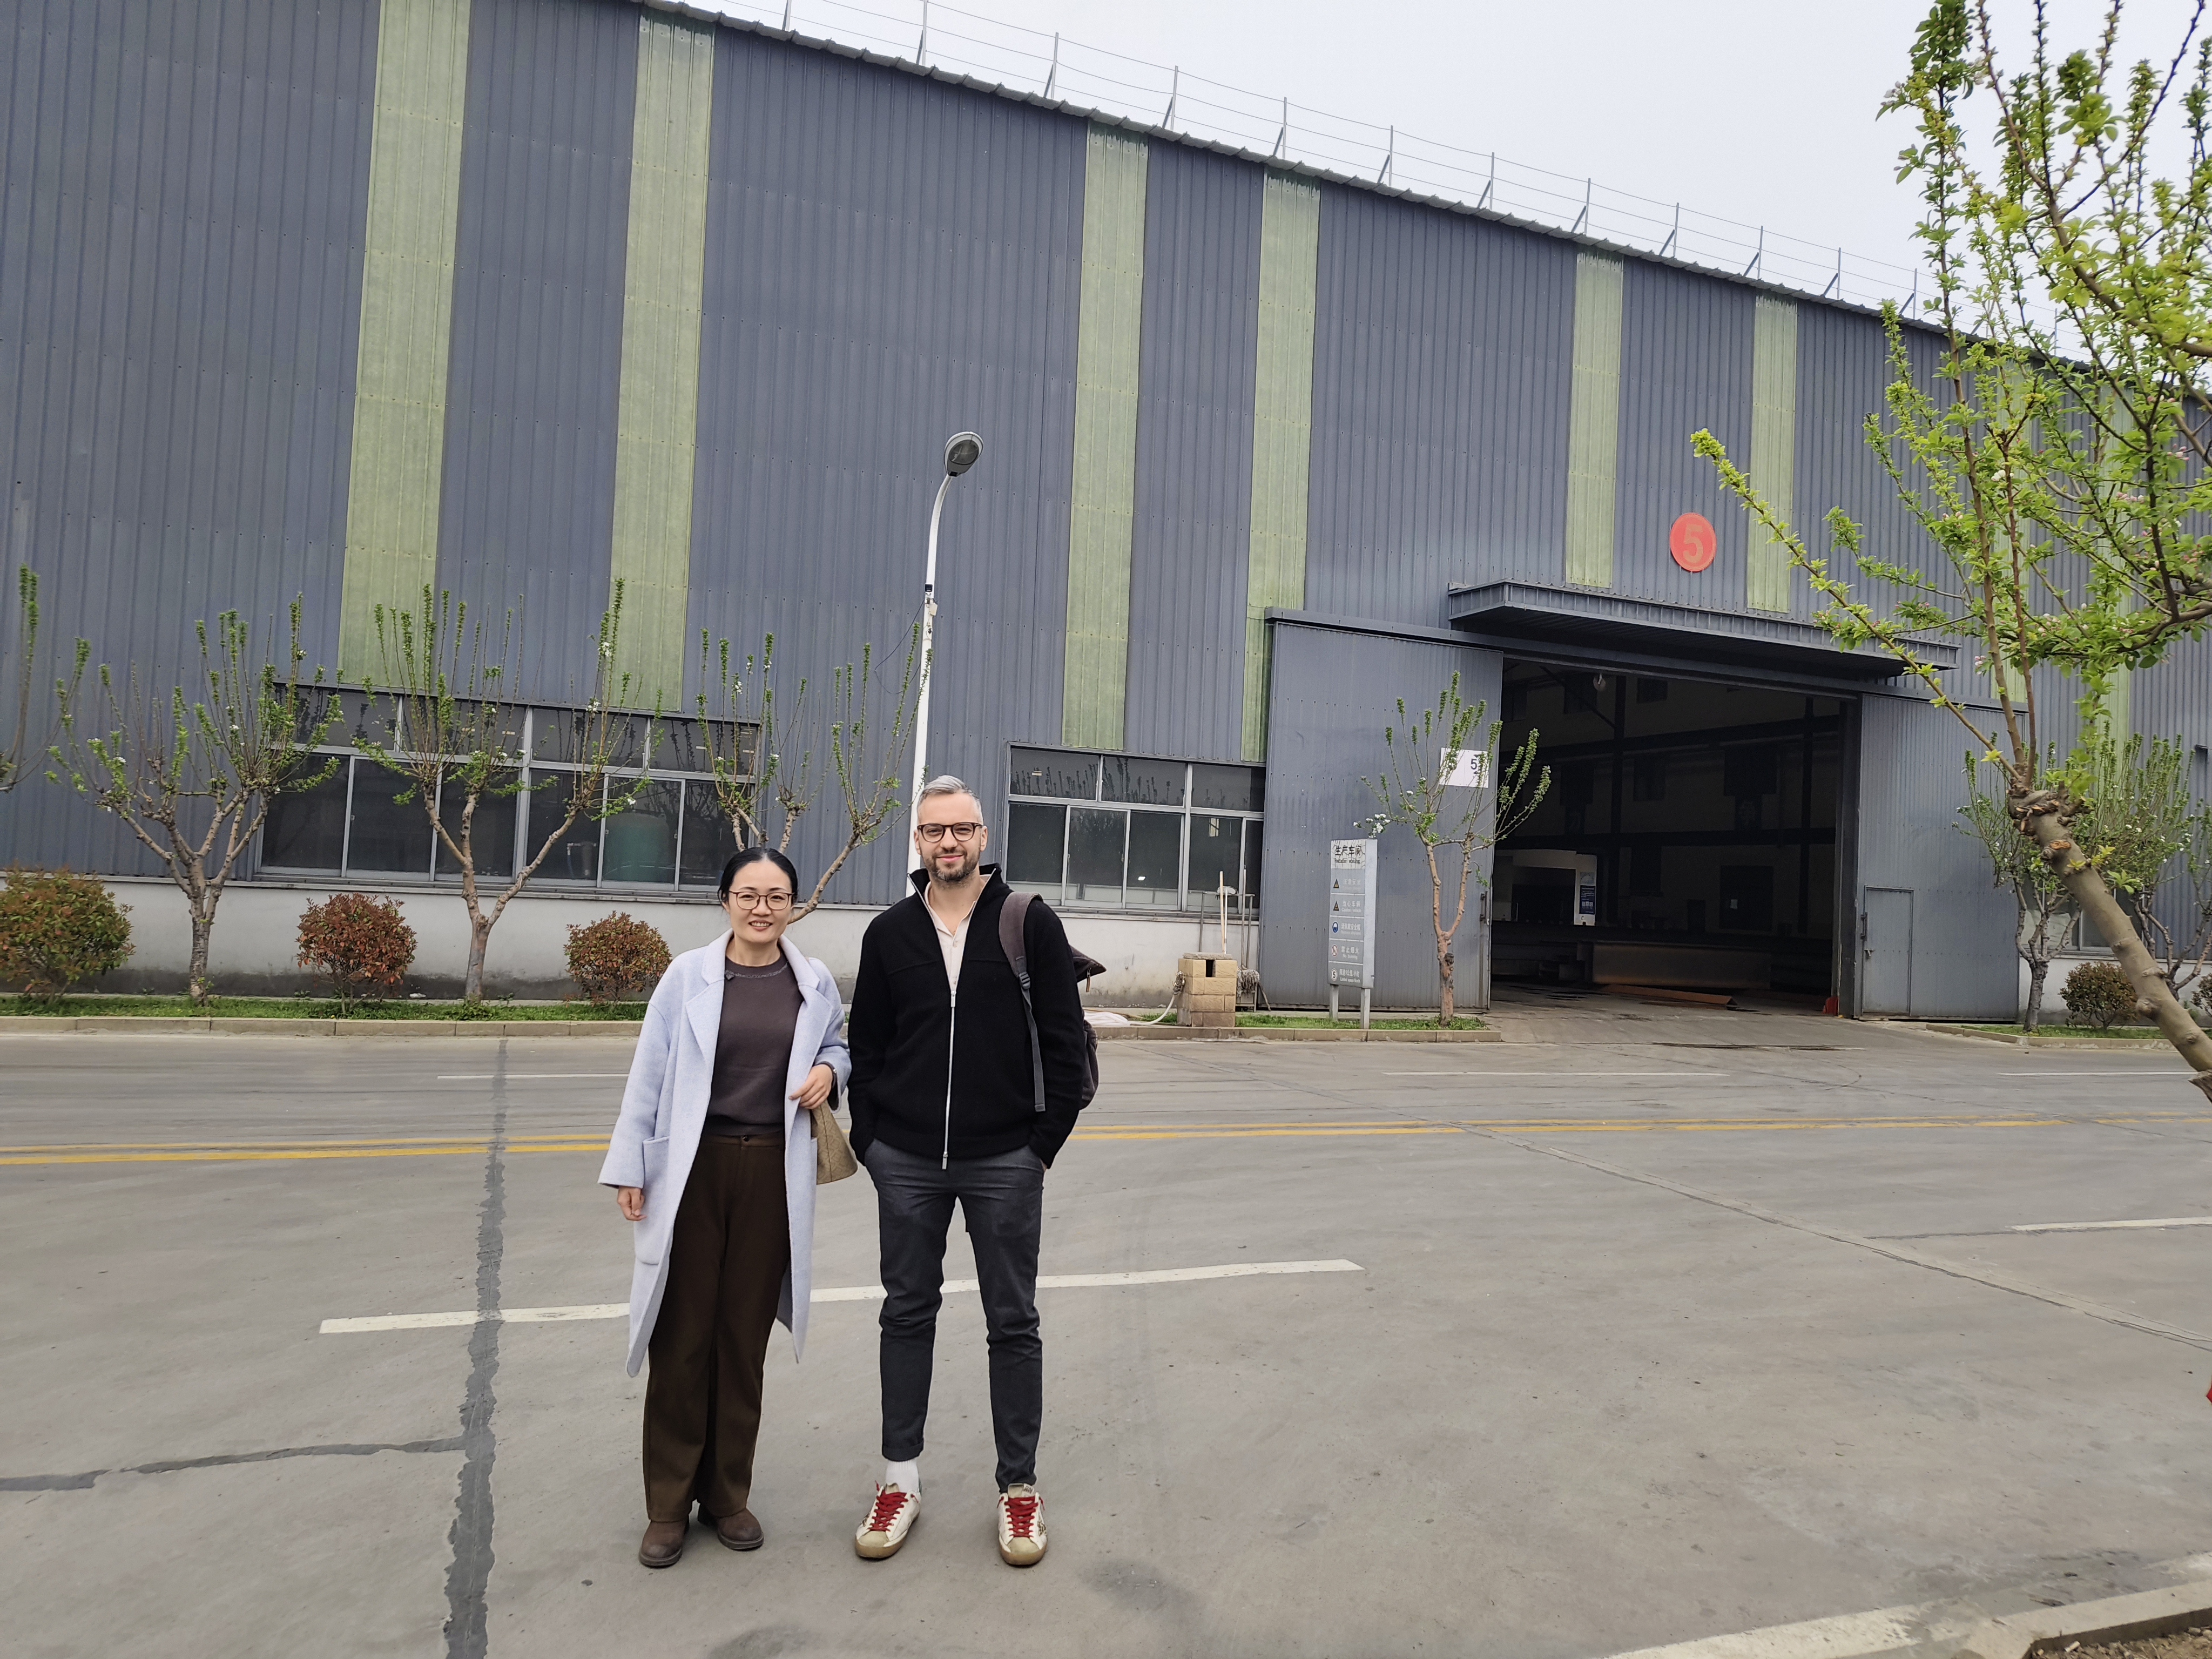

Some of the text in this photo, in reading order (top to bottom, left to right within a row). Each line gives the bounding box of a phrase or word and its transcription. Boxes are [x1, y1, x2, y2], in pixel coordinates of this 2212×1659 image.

[1683, 524, 1703, 563] 5
[1335, 845, 1361, 857] 生产车间
